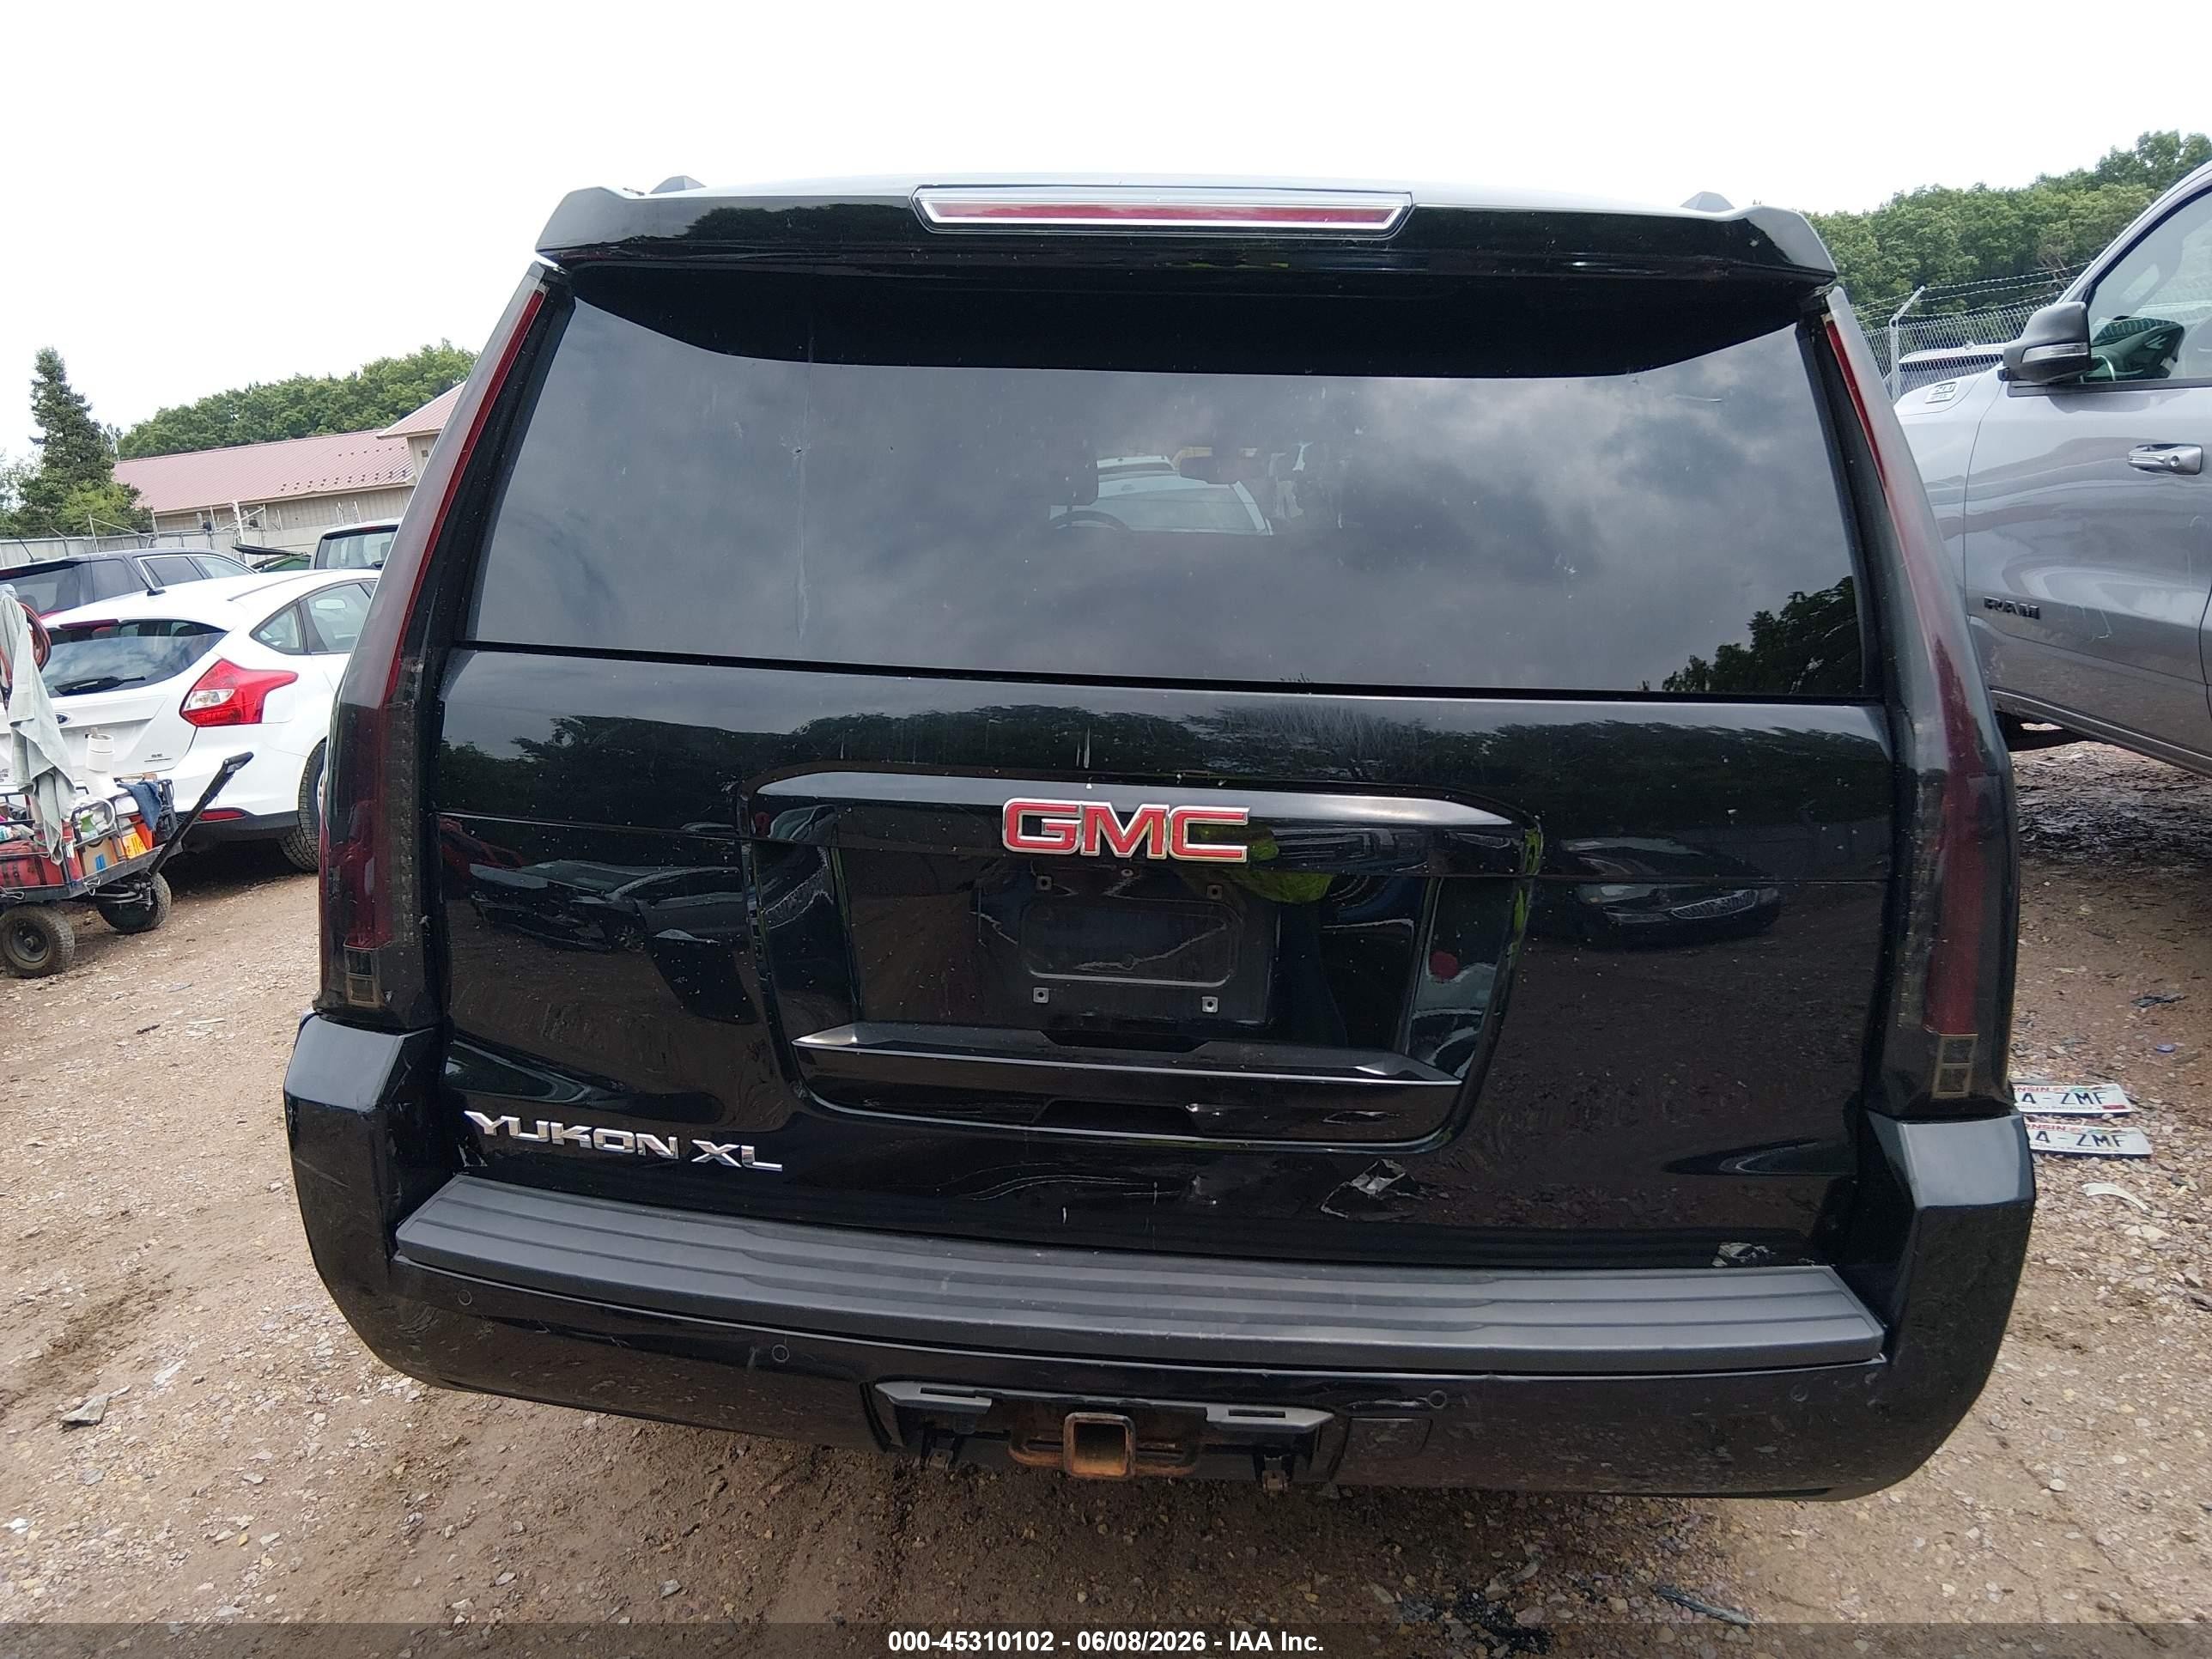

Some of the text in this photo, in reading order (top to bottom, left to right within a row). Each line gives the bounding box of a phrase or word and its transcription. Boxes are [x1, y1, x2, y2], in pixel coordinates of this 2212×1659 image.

[1984, 596, 2040, 619] RAM
[1003, 798, 1250, 862] GMC
[464, 1110, 782, 1171] YUKON XL
